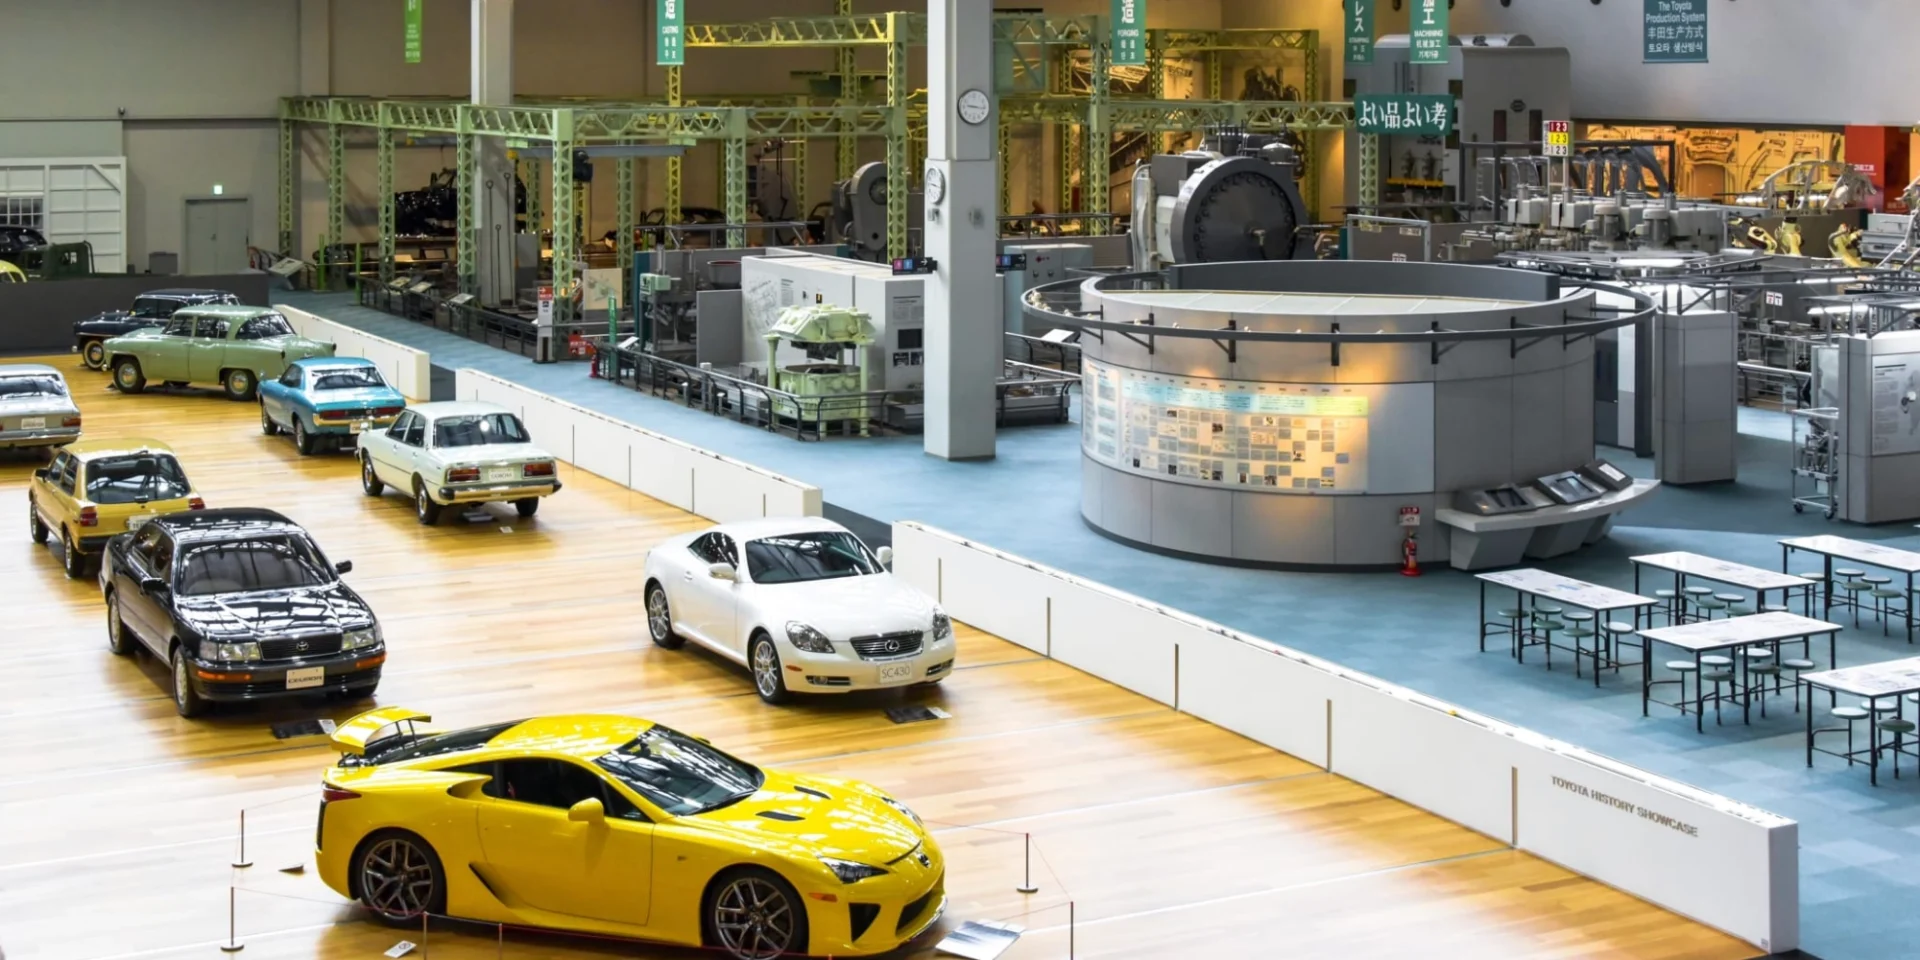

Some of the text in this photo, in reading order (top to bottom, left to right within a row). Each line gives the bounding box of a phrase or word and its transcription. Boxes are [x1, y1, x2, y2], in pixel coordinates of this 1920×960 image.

[1658, 1, 1692, 13] The Toyota
[1645, 12, 1705, 24] Production System
[1414, 29, 1444, 37] MACHINING
[1648, 25, 1704, 39] 丰田生产方式
[1359, 100, 1447, 131] よい品よい考
[881, 666, 911, 679] SC430
[1551, 776, 1698, 837] TOYOTA HISTORY SHOWCASE
